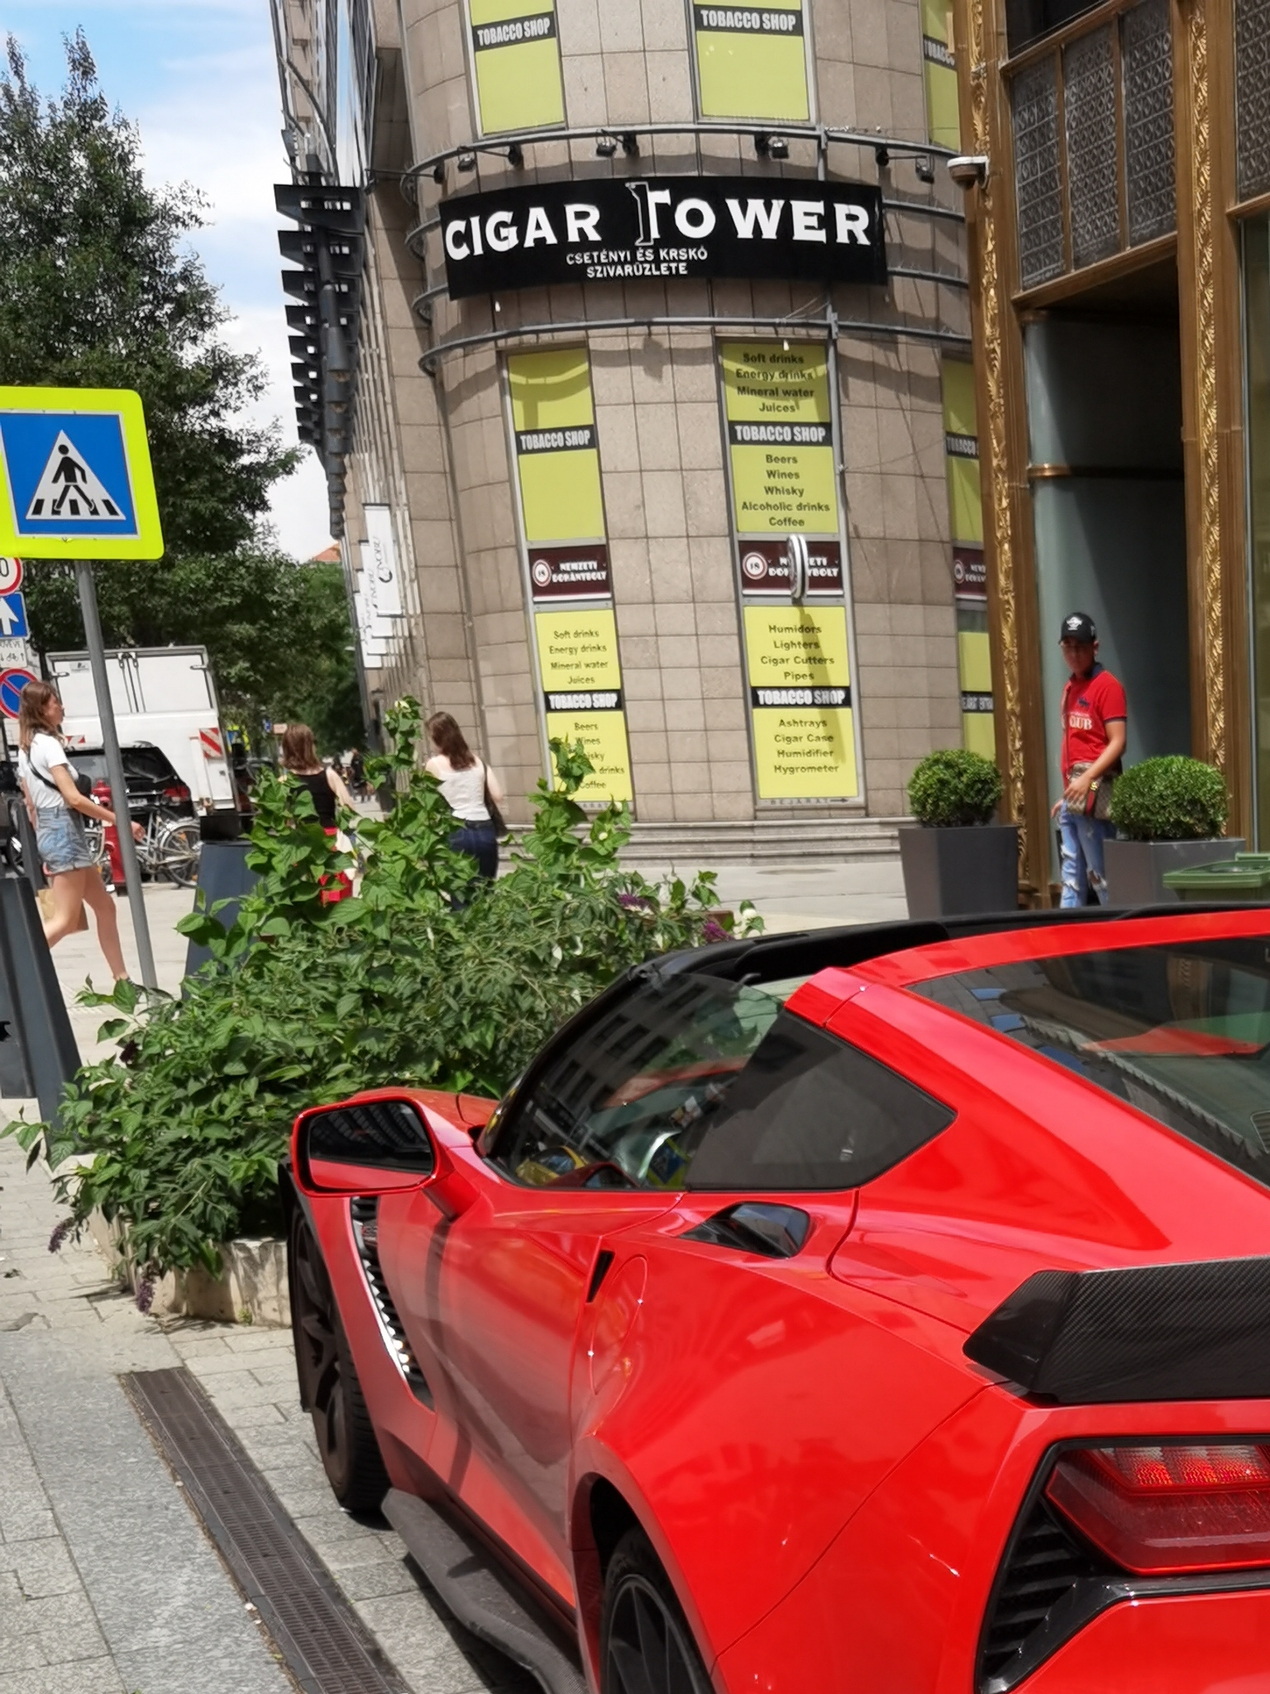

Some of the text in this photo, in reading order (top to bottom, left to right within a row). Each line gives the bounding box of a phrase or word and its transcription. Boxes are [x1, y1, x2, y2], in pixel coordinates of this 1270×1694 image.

[701, 9, 797, 32] TOBACCO SHOP
[477, 17, 551, 46] TOBACCO SHOP
[445, 181, 871, 260] CIGAR TOWER
[566, 244, 708, 265] CSETÉNYI ÉS KRSKÓ
[586, 261, 688, 279] SZIVARÜZLETE
[743, 353, 805, 364] Soft drinks
[735, 368, 814, 381] Energy drinks
[737, 386, 815, 398] Mineral water
[759, 402, 796, 412] Juices
[734, 425, 826, 442] TOBACCO SHOP
[520, 430, 591, 450] TOBACCO SHOP
[766, 454, 798, 464] Beers
[766, 469, 800, 480] Wines
[764, 486, 805, 498] Whisky
[741, 501, 830, 512] Alcoholic drinks
[769, 517, 805, 527] Coffee
[553, 629, 600, 639] Soft drinks
[768, 624, 822, 634] Humidors
[548, 644, 607, 655] Energy drinks
[773, 640, 821, 651] Lighters
[550, 661, 608, 670] Mineral water
[760, 655, 835, 667] Cigar Cutters
[567, 676, 596, 685] Juices
[783, 671, 815, 682] Pipes
[548, 692, 618, 709] TOBACCO SHOP
[756, 690, 846, 705] TOBACCO SHOP
[574, 722, 598, 731] Beers
[778, 719, 828, 728] Ashtrays
[774, 733, 835, 745] Cigar Case
[777, 749, 834, 758] Humidifier
[599, 766, 625, 774] drinks
[774, 764, 840, 775] Hygrometer
